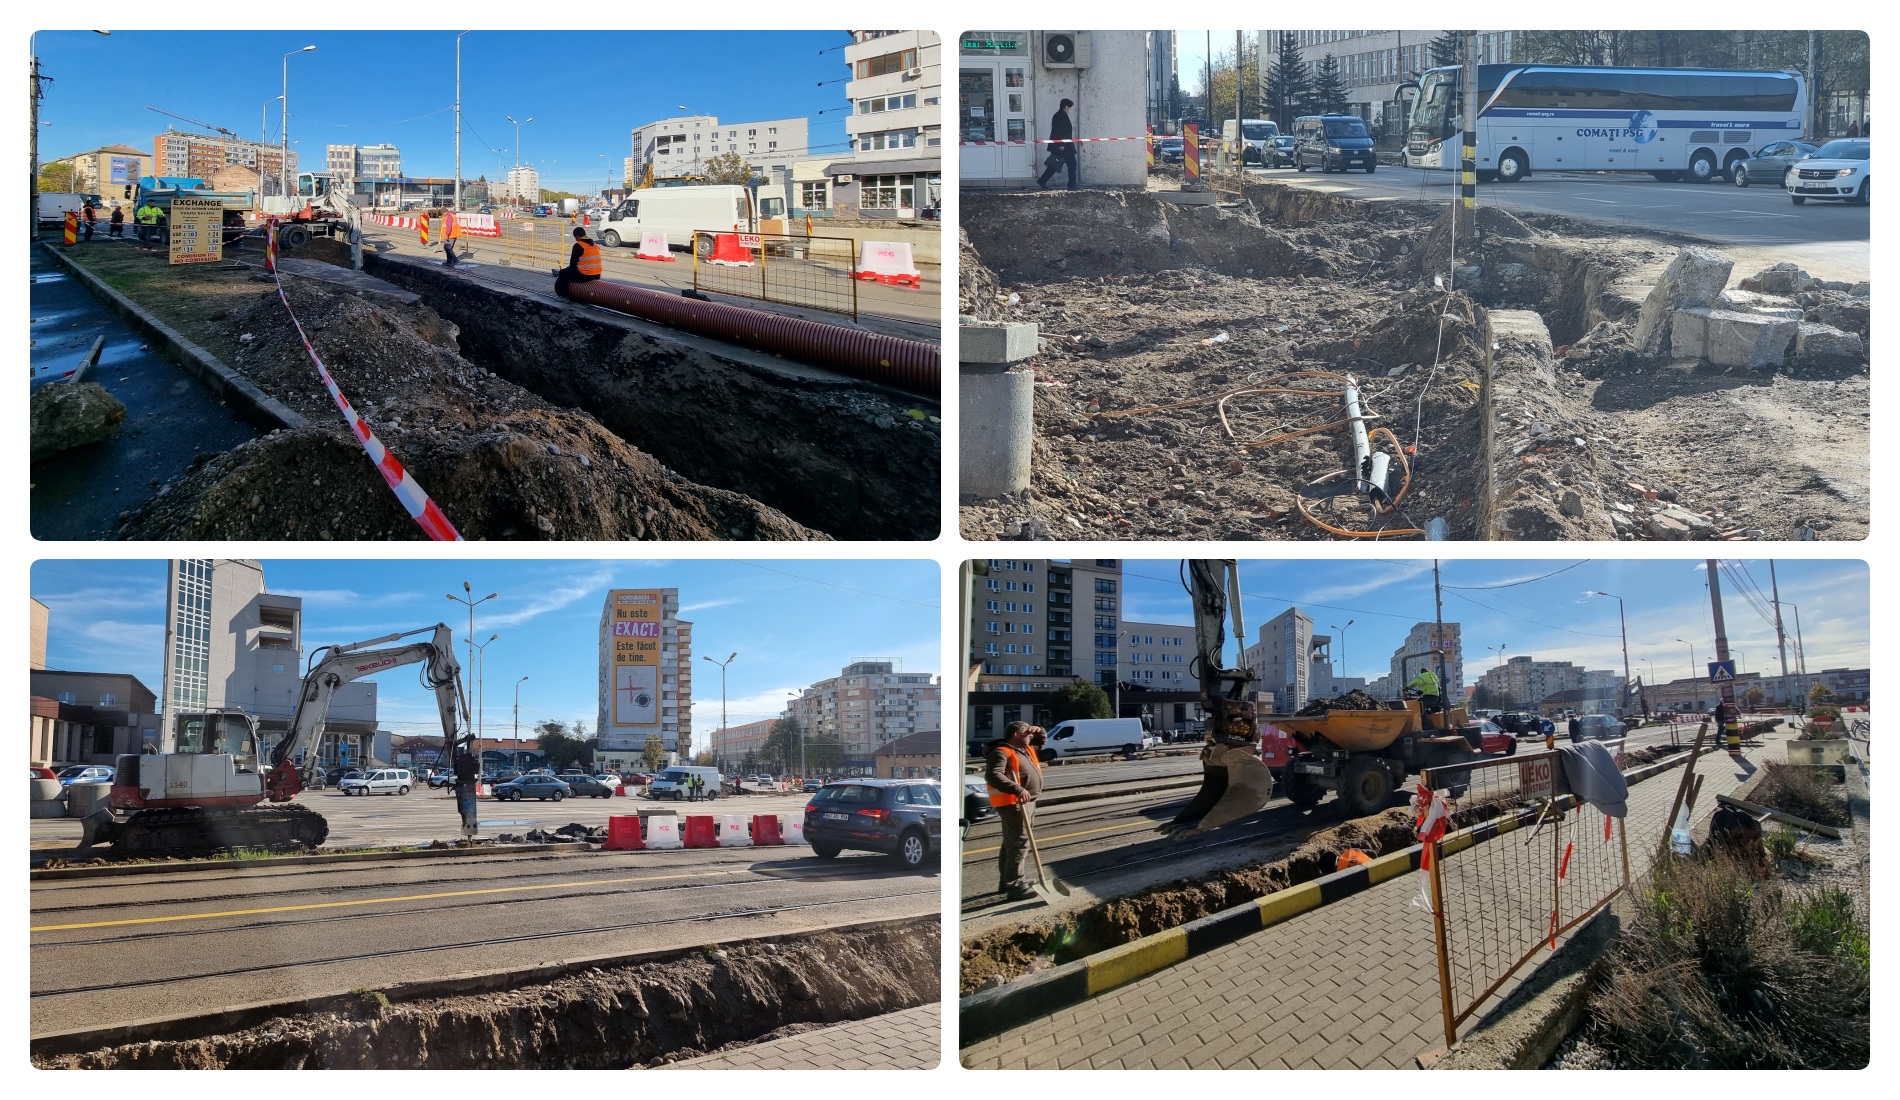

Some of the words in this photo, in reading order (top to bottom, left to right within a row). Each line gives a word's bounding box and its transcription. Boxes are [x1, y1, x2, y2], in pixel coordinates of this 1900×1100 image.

[1622, 129, 1644, 137] PSG
[617, 609, 626, 618] Nu
[630, 609, 648, 618] este
[616, 621, 657, 637] EXACT.
[617, 641, 633, 650] Este
[637, 641, 656, 650] făcut
[617, 653, 625, 661] de
[629, 653, 646, 661] tine.
[355, 658, 397, 672] TAKEUCHI
[1522, 763, 1549, 783] LEKO
